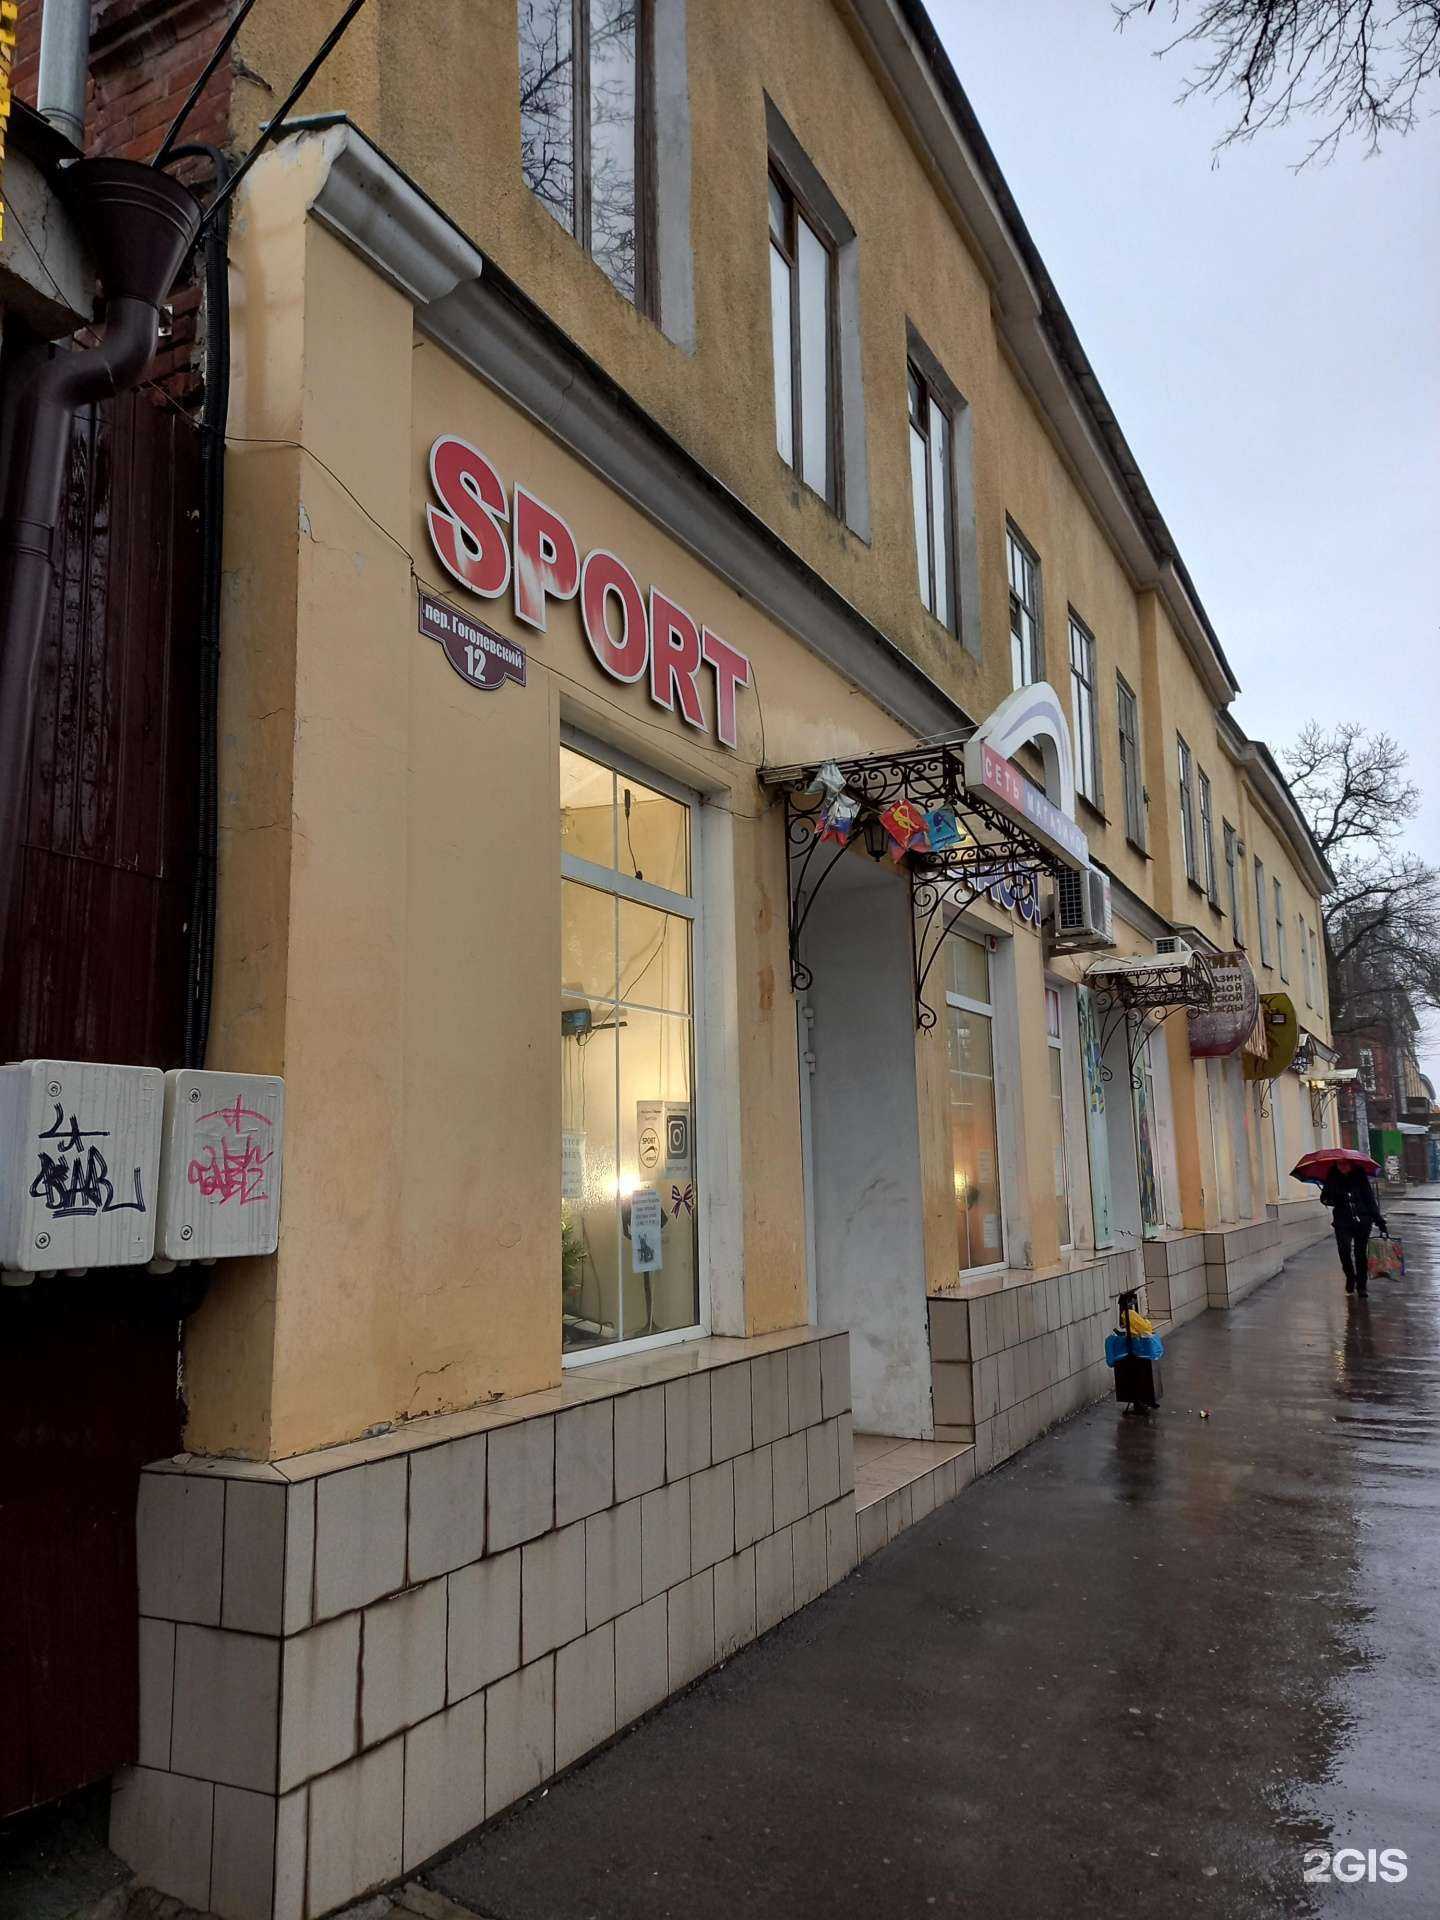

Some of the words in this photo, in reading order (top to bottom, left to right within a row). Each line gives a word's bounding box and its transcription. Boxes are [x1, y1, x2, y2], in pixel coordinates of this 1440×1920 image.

[425, 434, 751, 750] SPORT
[425, 603, 451, 631] пер.
[452, 615, 523, 669] Гоголевский
[464, 644, 486, 682] 12
[985, 757, 1020, 800] СЕТЬ
